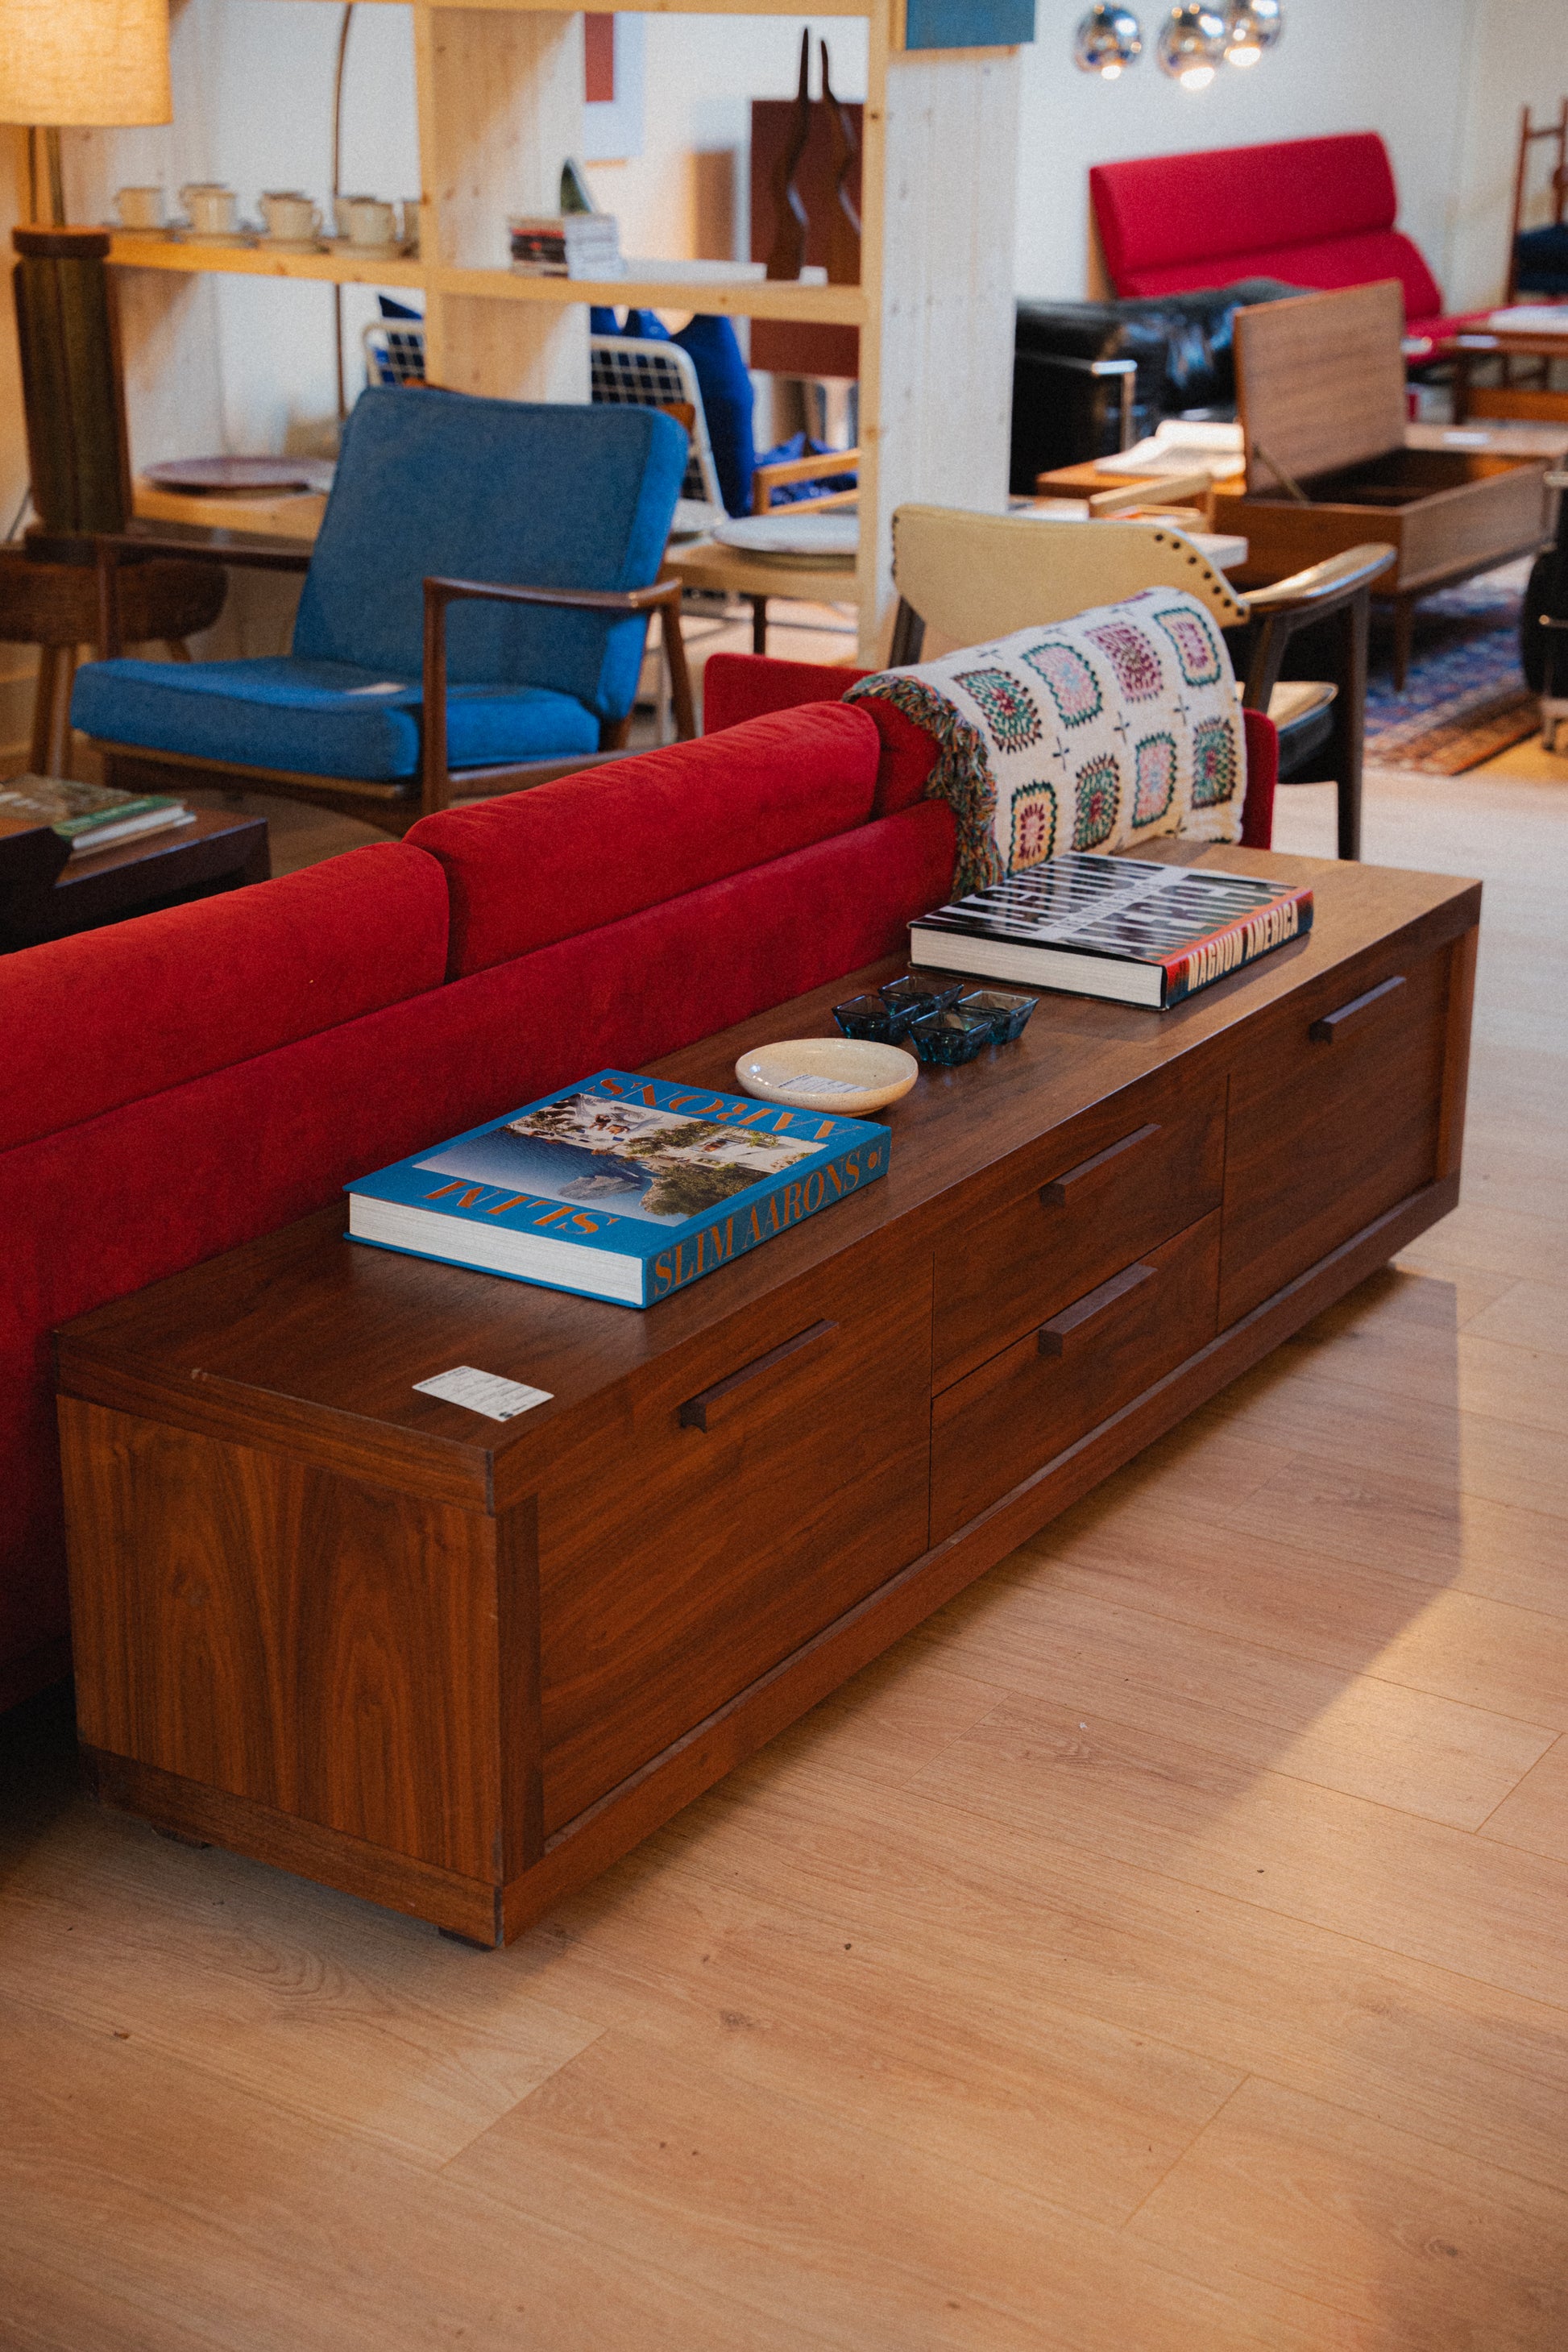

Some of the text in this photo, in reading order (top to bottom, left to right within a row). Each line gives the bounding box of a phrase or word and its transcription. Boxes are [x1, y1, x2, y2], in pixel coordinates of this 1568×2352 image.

[914, 853, 1165, 936] MAGNUM
[1064, 874, 1297, 961] AMERICA
[1187, 900, 1298, 992] MAGNUM AMERICA
[587, 1077, 865, 1139] AARONS
[418, 1180, 620, 1234] SLIM
[654, 1151, 861, 1296] SLIM AARONS
